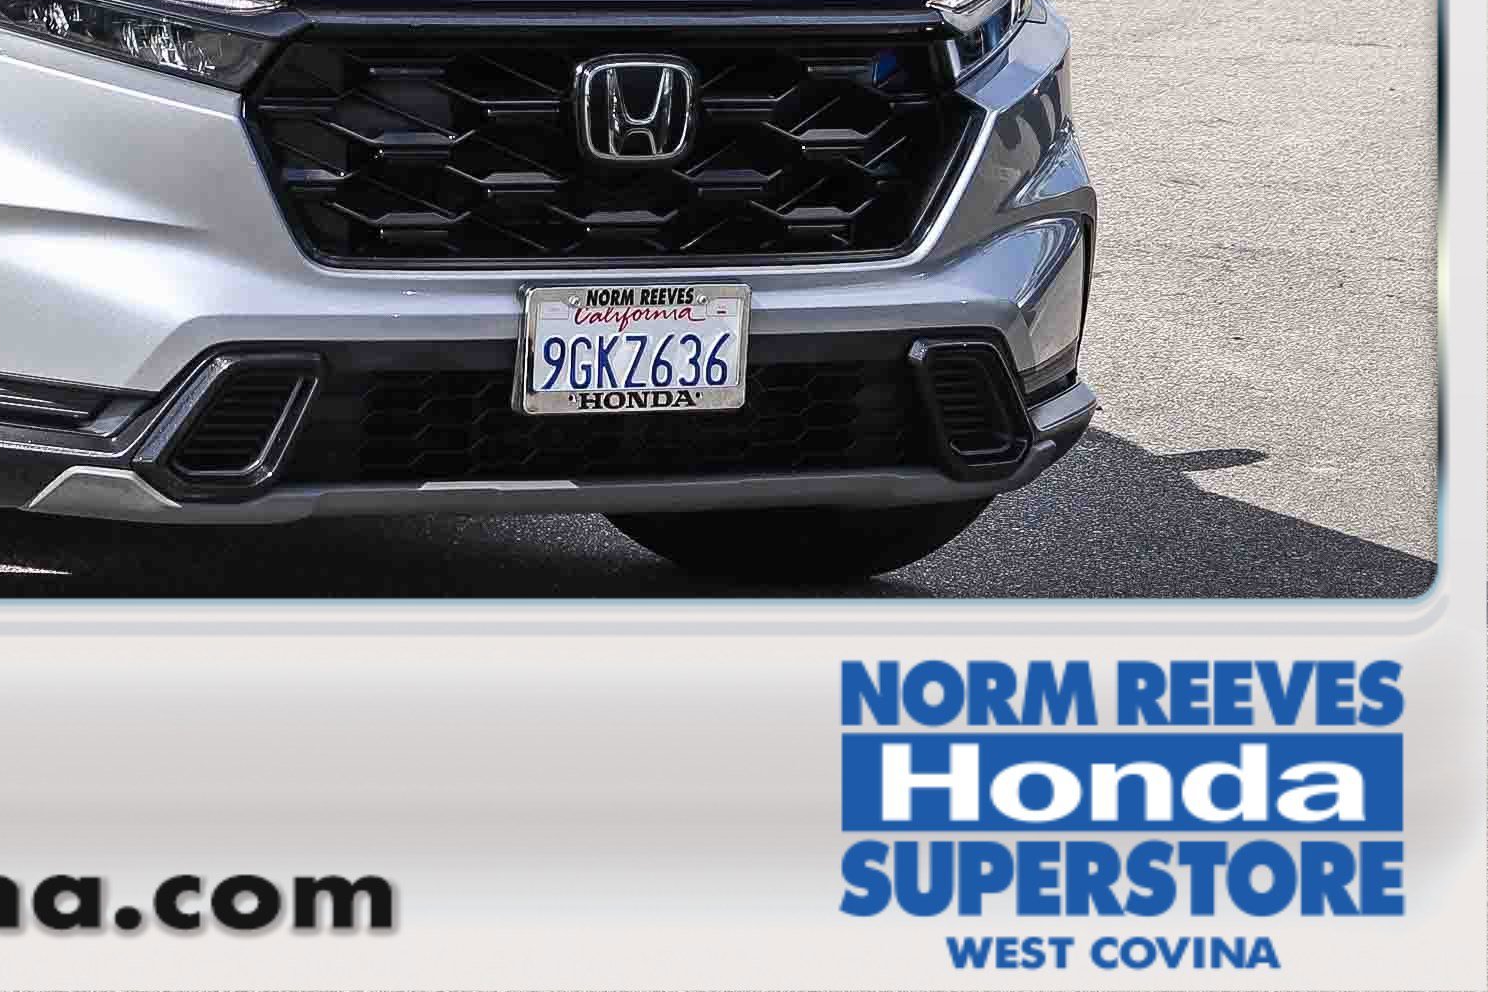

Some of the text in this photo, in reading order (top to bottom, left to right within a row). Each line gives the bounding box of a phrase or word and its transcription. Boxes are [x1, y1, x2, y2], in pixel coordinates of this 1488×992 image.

[586, 288, 694, 306] NORM REEVES
[574, 306, 706, 332] California
[541, 332, 731, 390] 9GKZ636
[576, 390, 698, 410] HONDA
